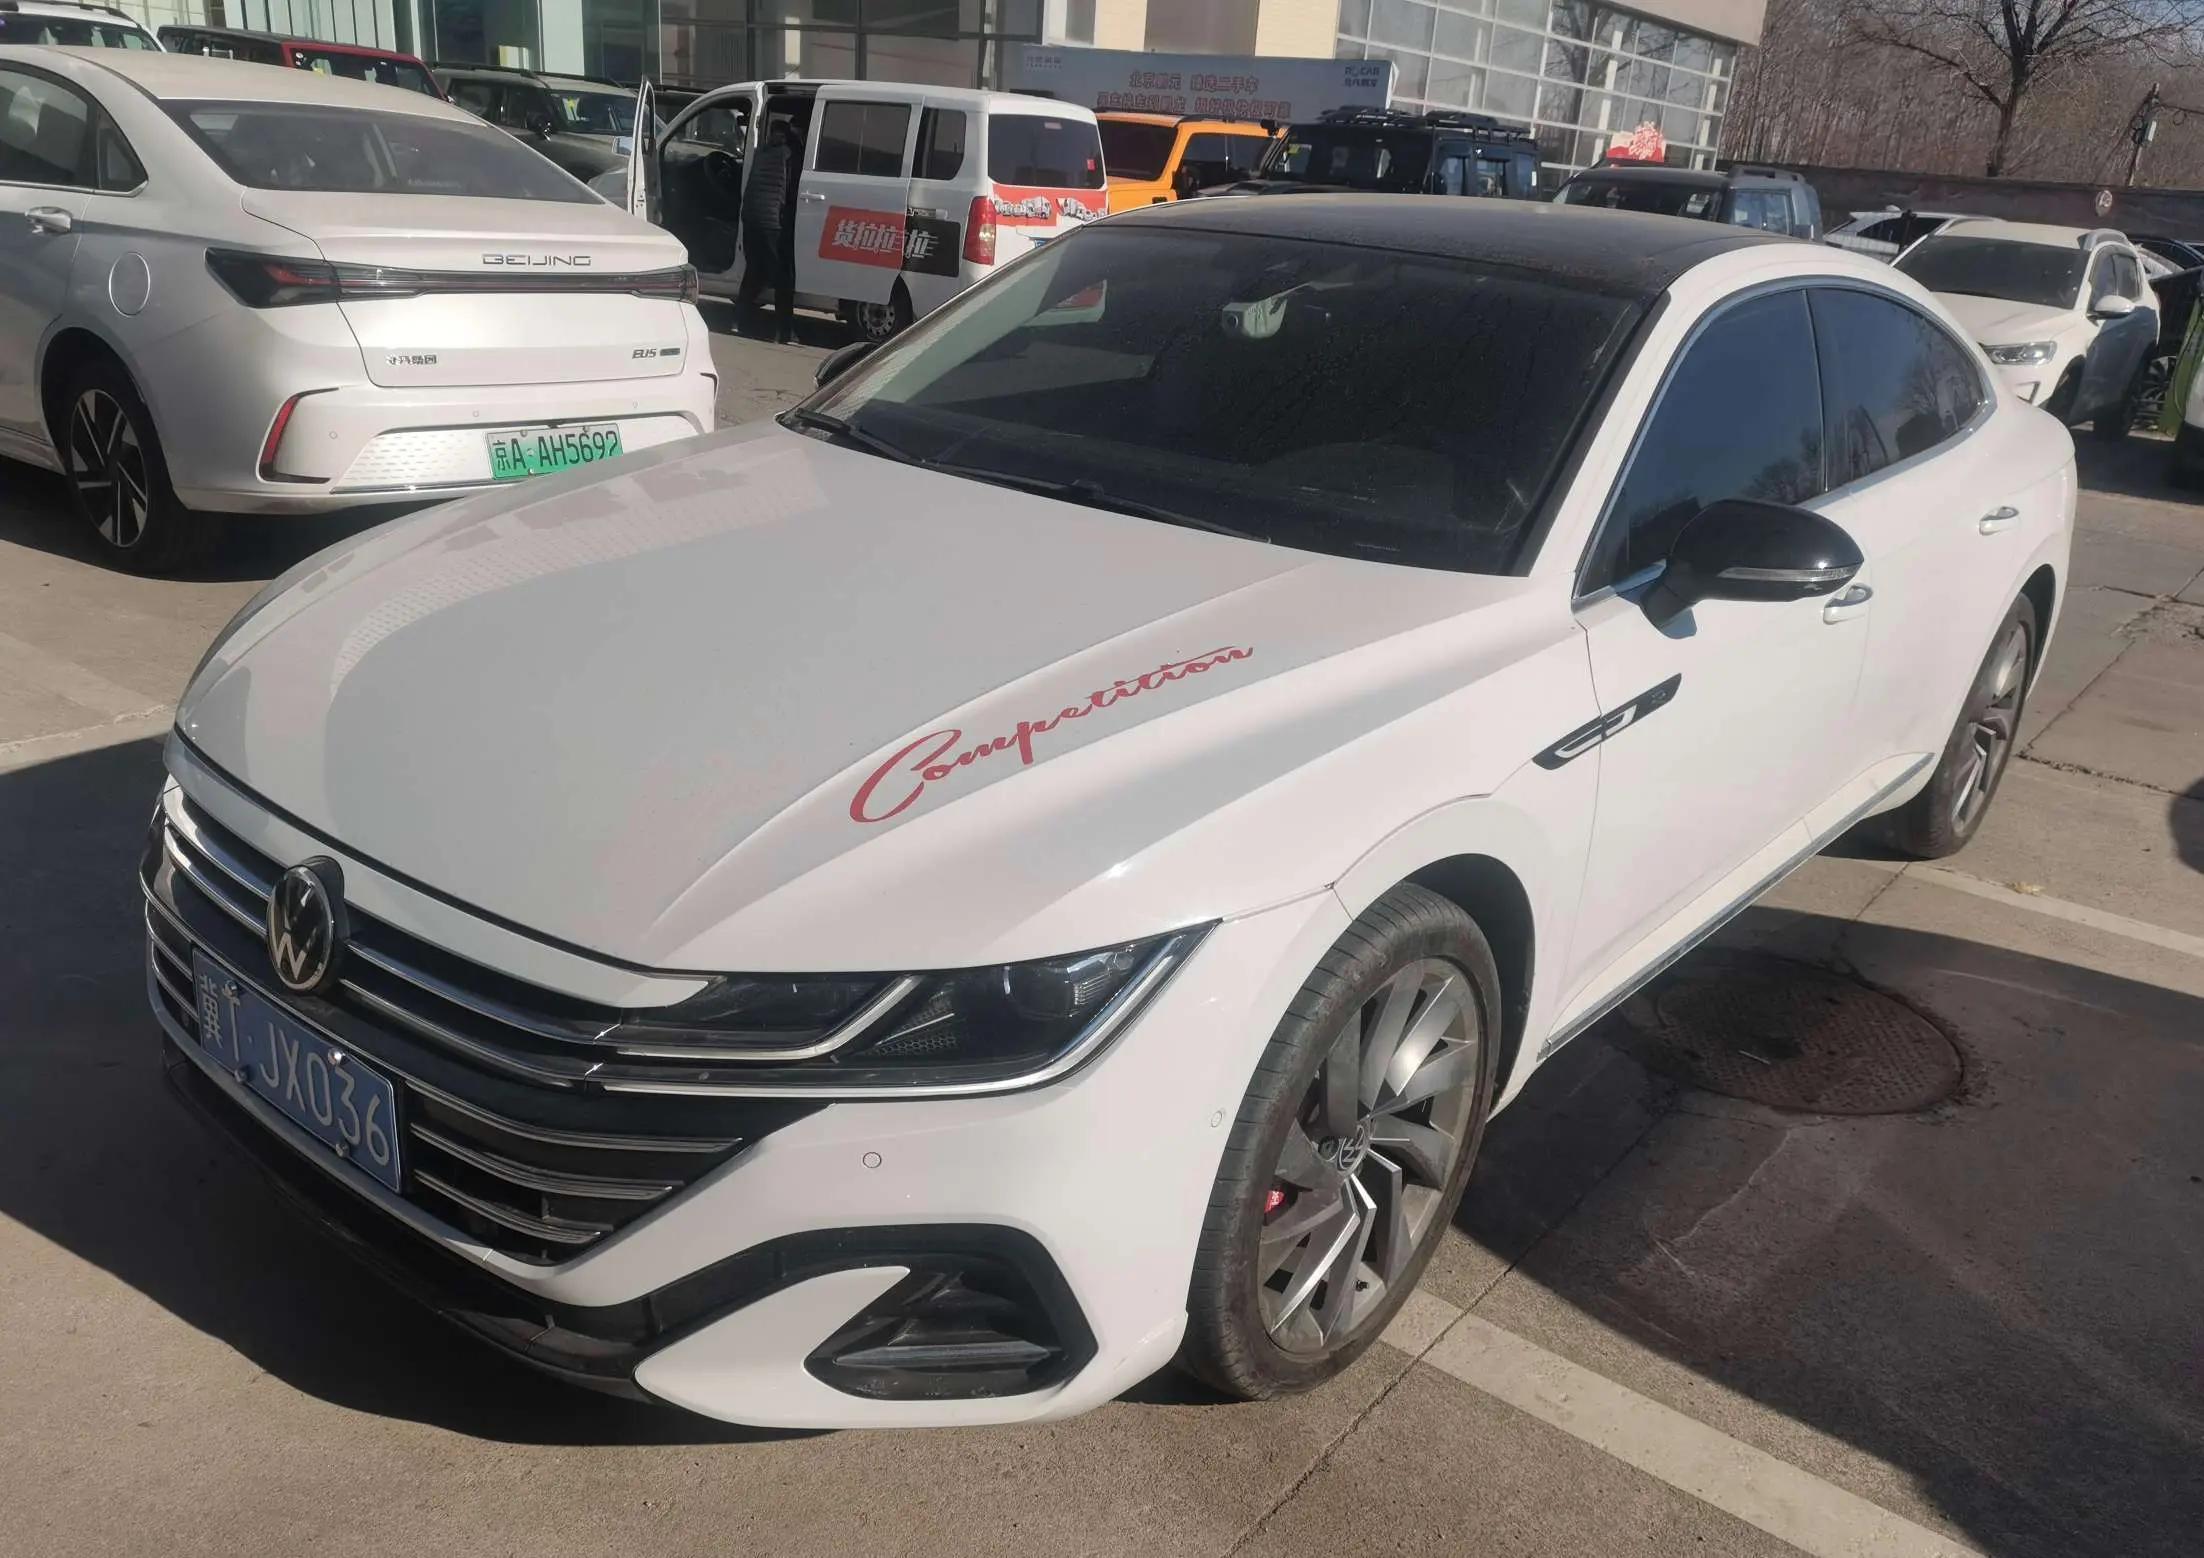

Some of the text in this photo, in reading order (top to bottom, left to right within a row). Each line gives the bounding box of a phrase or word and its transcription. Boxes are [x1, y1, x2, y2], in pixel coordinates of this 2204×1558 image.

[833, 218, 897, 255] 货拉拉
[482, 254, 591, 266] BEIJING
[848, 645, 1254, 824] Competition
